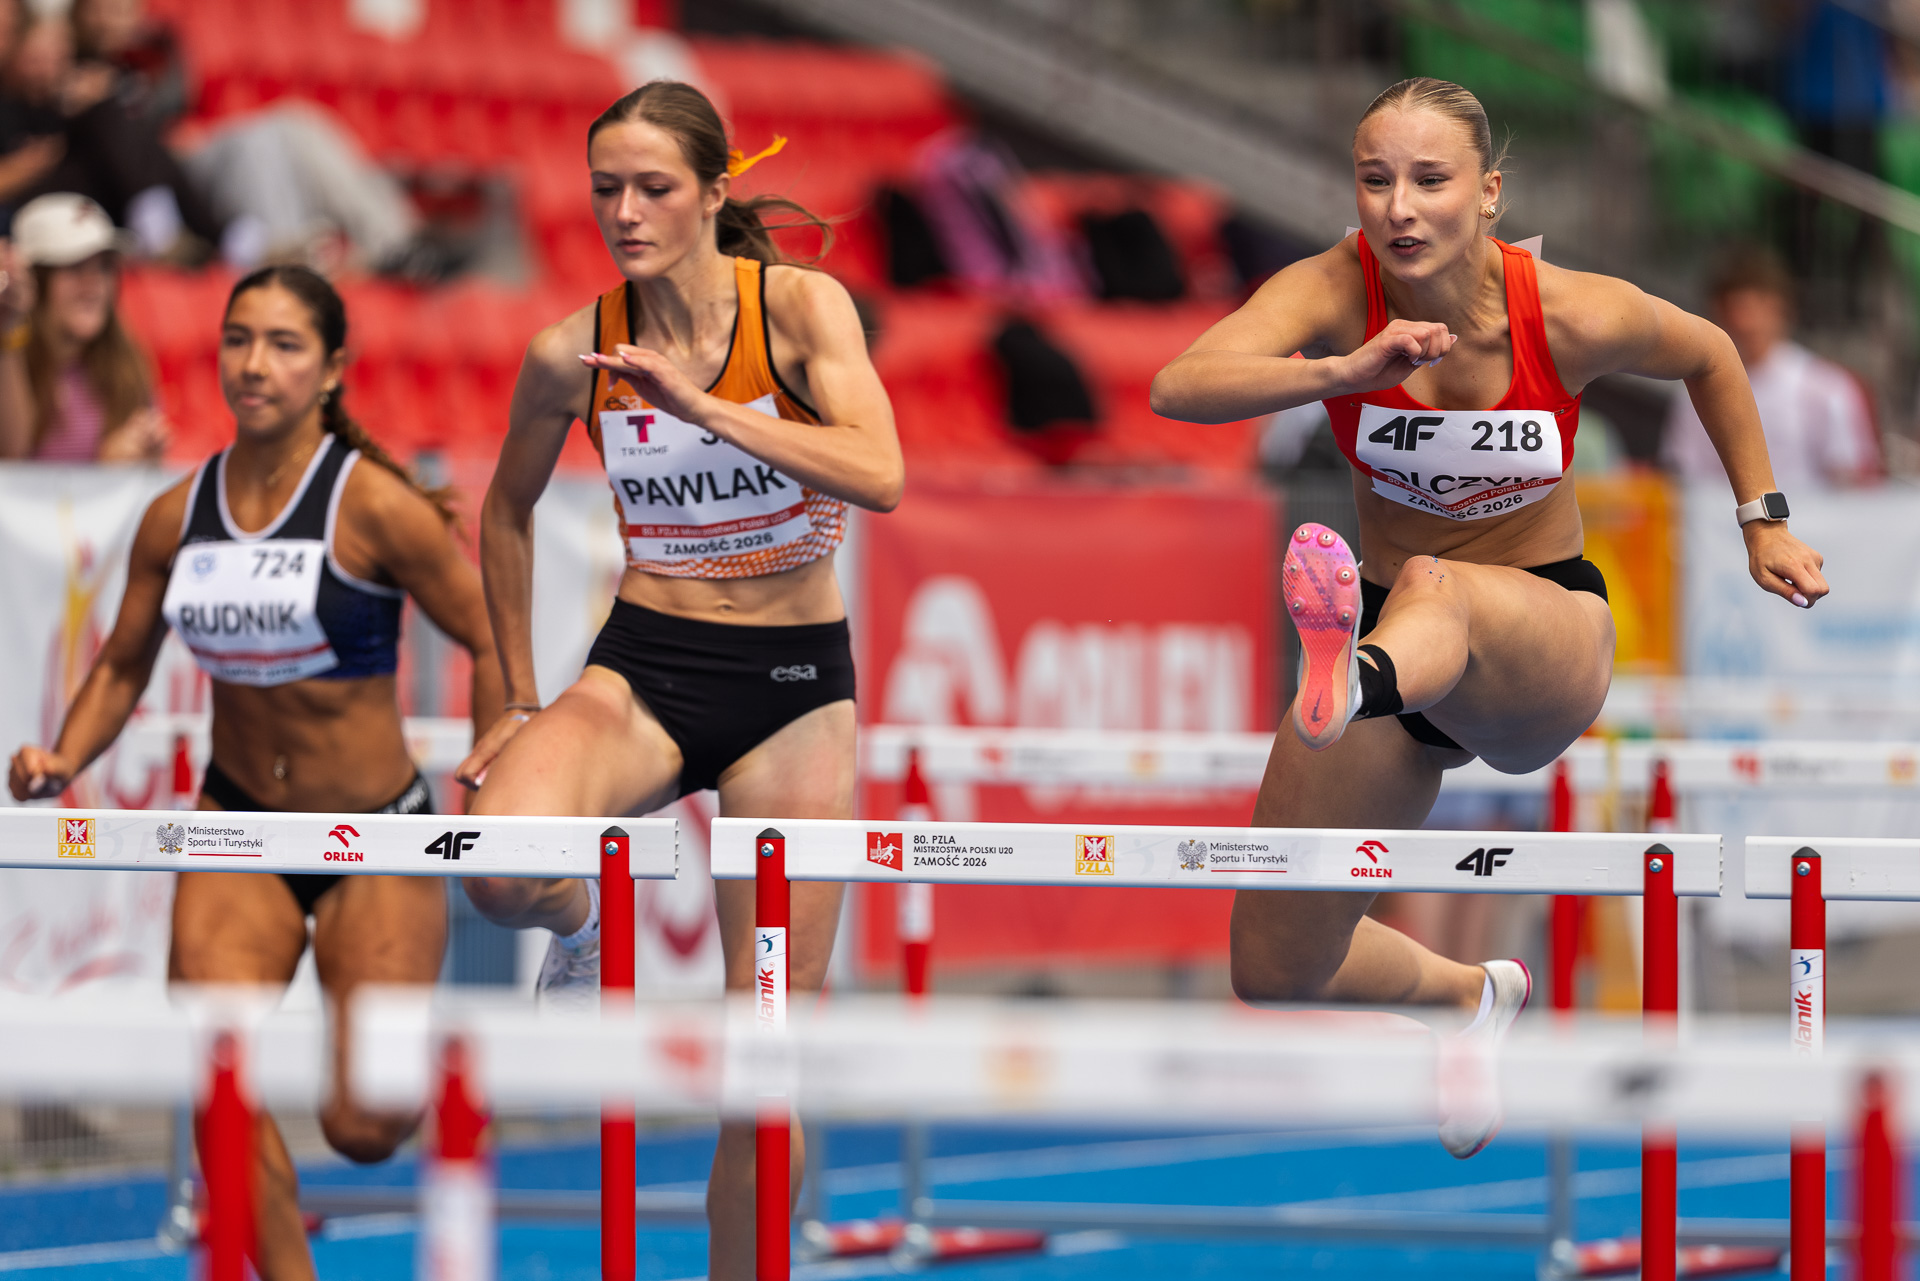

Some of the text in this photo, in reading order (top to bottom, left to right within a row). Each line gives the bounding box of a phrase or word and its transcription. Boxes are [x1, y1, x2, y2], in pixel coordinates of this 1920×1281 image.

[605, 396, 642, 410] esa
[1369, 416, 1444, 451] 4F
[1471, 421, 1542, 451] 218
[621, 445, 669, 456] TRYUMF
[620, 465, 786, 506] PAWLAK
[1490, 484, 1522, 497] Polski
[1523, 479, 1544, 489] U20
[1407, 493, 1523, 519] ZAMOŚĆ 2026
[740, 516, 770, 531] Polski
[664, 532, 774, 555] ZAMOŚĆ 2026
[252, 549, 305, 577] 724
[180, 600, 300, 636] RUDNIK
[770, 663, 817, 682] esa
[188, 827, 245, 836] Ministerstwo
[188, 838, 217, 849] Sportu
[223, 838, 263, 849] Turystyki
[425, 832, 481, 860] 4F
[914, 835, 956, 845] 80. PZLA
[60, 845, 93, 857] PZLA
[914, 846, 1014, 855] MISTRZOSTWA POLSKI U20
[1210, 843, 1269, 852] Ministerstwo
[324, 851, 364, 862] ORLEN
[914, 854, 987, 867] ZAMOŚĆ 2026
[1210, 854, 1240, 864] Sportu
[1247, 855, 1288, 866] Turystyki
[1456, 848, 1514, 876] 4F
[1077, 861, 1111, 873] PZLA
[1351, 866, 1392, 878] ORLEN
